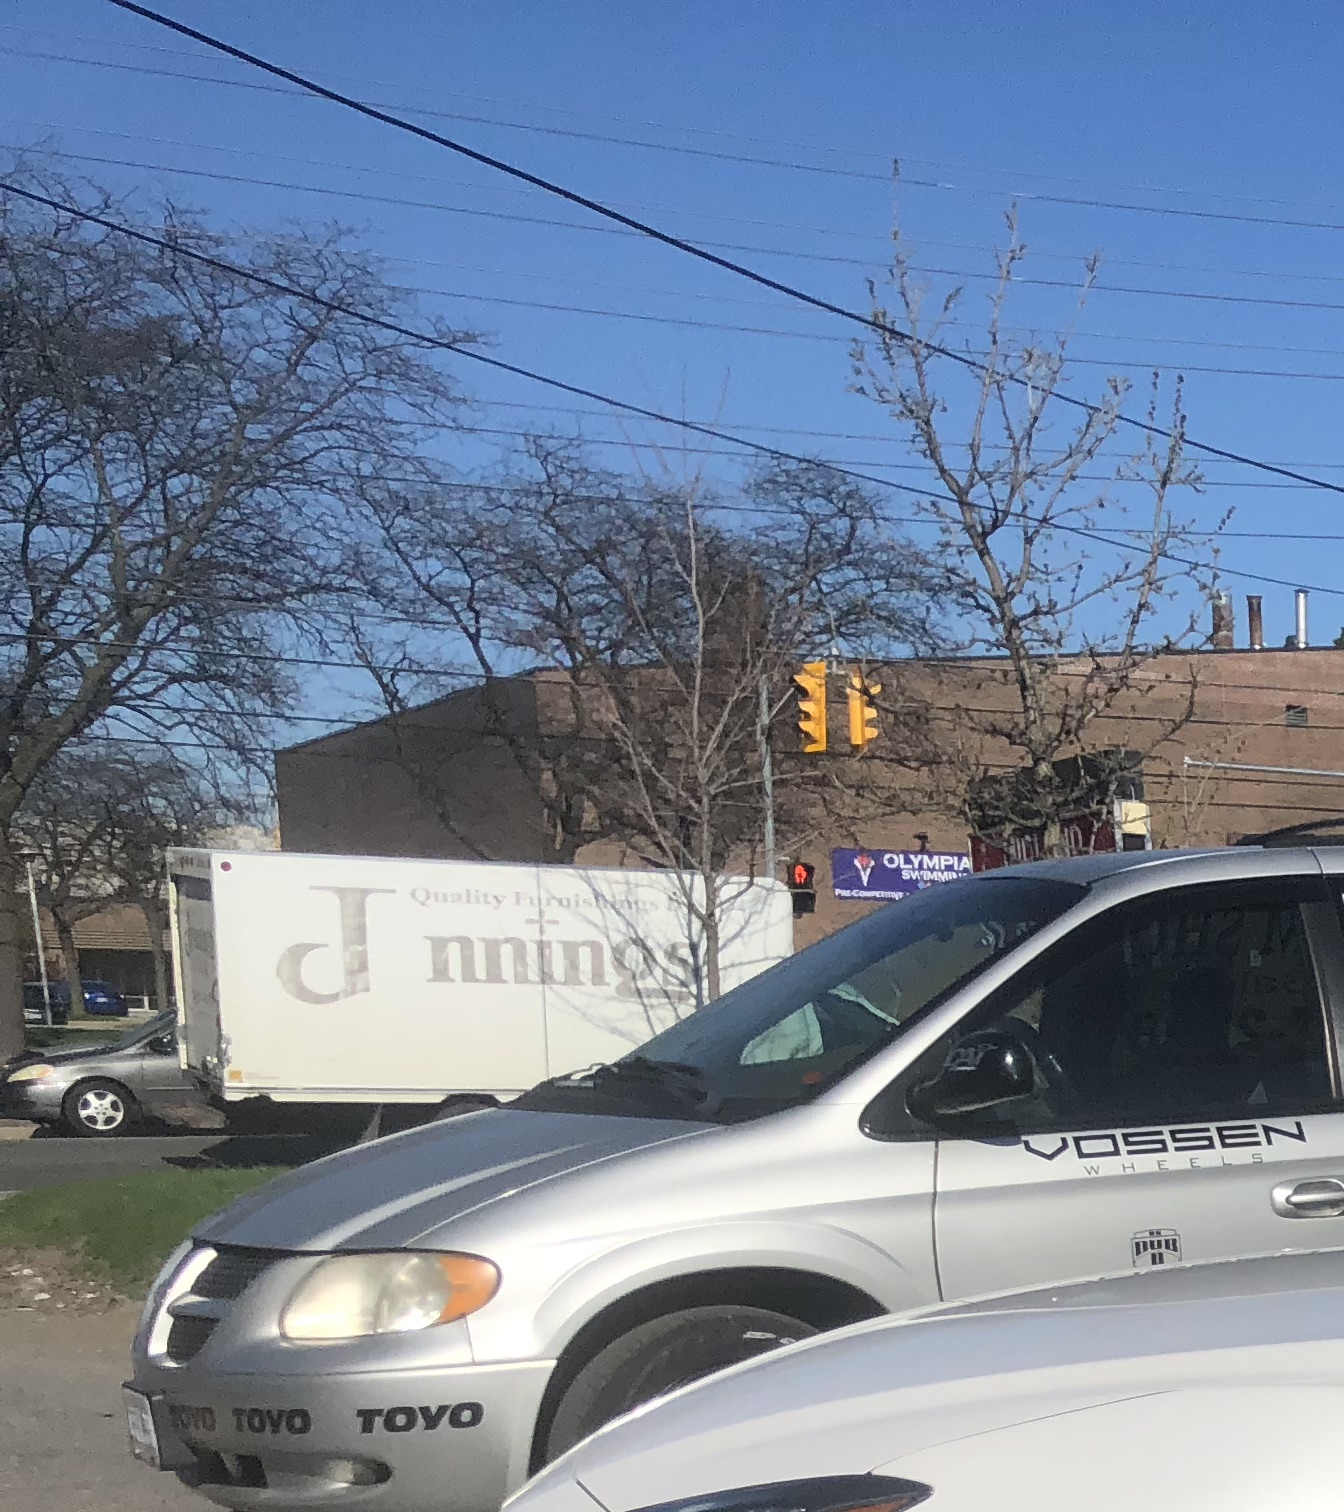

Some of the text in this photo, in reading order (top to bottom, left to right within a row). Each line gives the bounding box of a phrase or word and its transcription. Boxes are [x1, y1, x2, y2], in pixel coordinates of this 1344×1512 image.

[1022, 1121, 1307, 1162] VOSSEN
[1083, 1153, 1264, 1177] WHEELS
[231, 1407, 312, 1435] TOYO
[356, 1401, 485, 1434] TOYO
